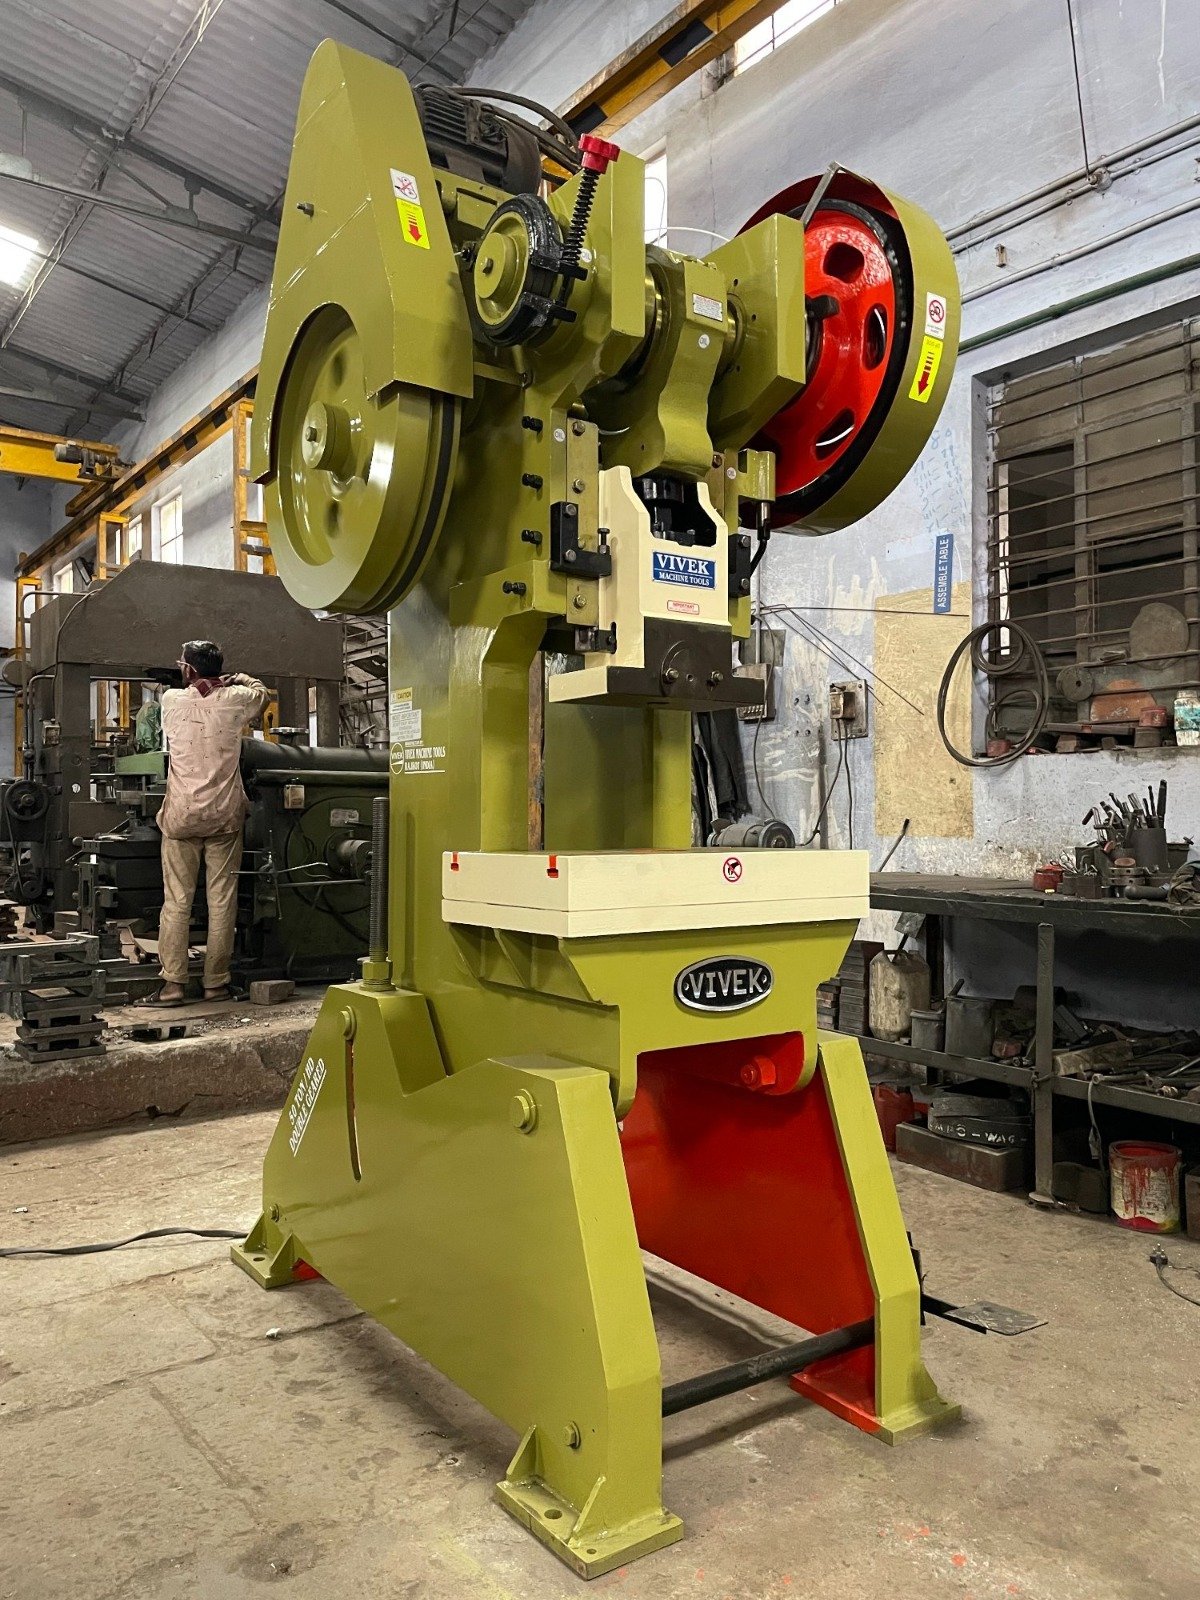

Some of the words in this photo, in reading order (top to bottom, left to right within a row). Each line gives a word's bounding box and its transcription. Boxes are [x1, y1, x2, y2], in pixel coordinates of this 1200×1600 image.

[656, 553, 710, 575] VIVEK
[939, 539, 949, 564] TABLE
[659, 571, 688, 583] MACHINE
[689, 576, 710, 587] TOOLS
[937, 565, 948, 608] ASSEMBLE
[432, 746, 446, 758] TOOLS
[688, 967, 764, 999] VIVEK
[288, 1104, 298, 1126] 50
[294, 1080, 307, 1108] TON
[305, 1057, 315, 1080] HD
[289, 1103, 309, 1153] DOUBLE
[305, 1058, 325, 1108] GEARED
